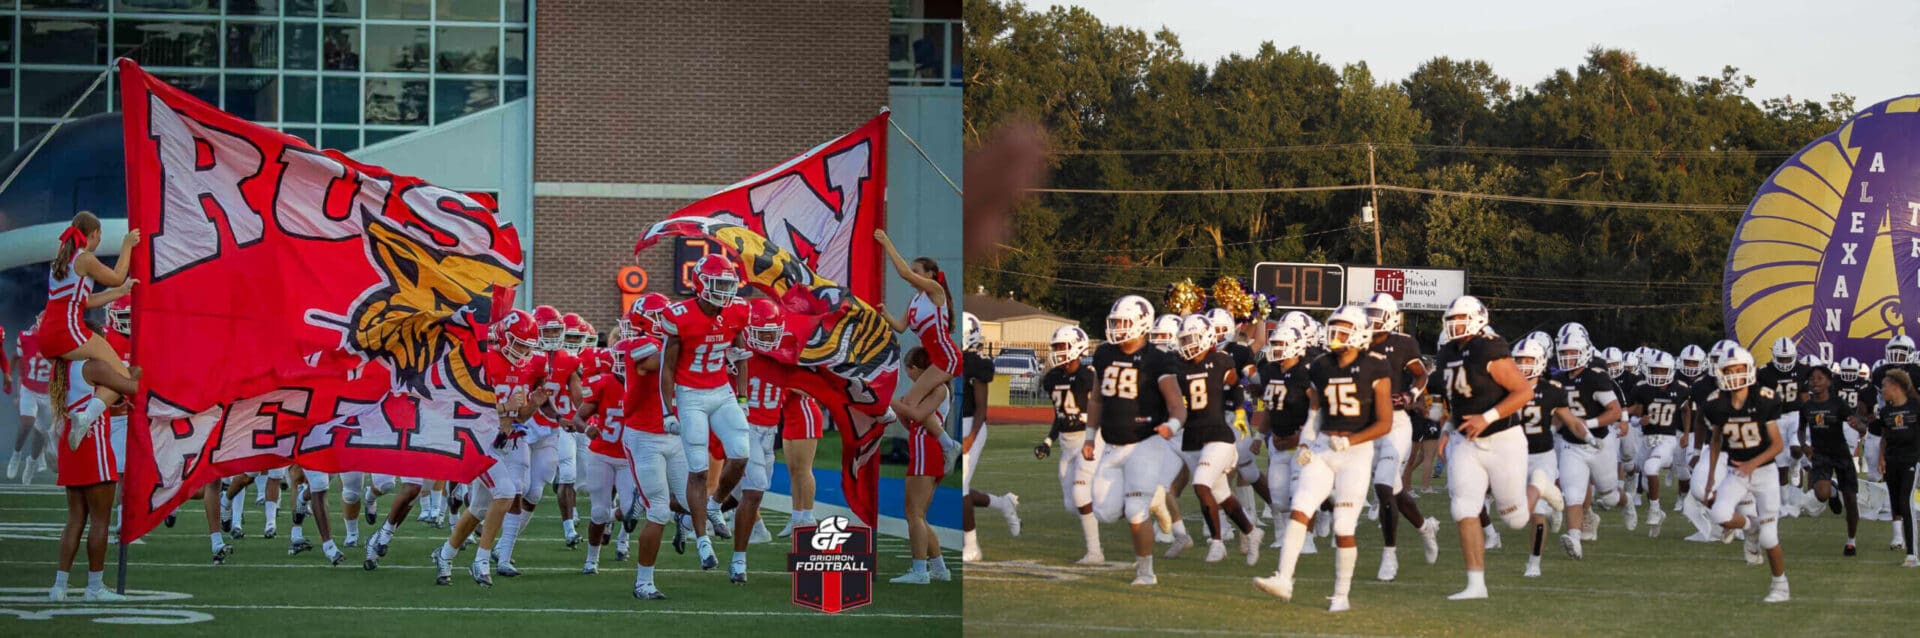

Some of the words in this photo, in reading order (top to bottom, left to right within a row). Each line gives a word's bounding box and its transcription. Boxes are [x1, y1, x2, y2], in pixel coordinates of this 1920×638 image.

[1275, 267, 1323, 305] 40
[1405, 278, 1437, 288] Physical
[28, 356, 52, 381] 12
[689, 341, 731, 373] 15
[1101, 365, 1138, 400] 68
[1188, 378, 1208, 410] 8
[1443, 366, 1472, 405] 74
[1324, 383, 1361, 416] 15
[601, 408, 624, 443] 5
